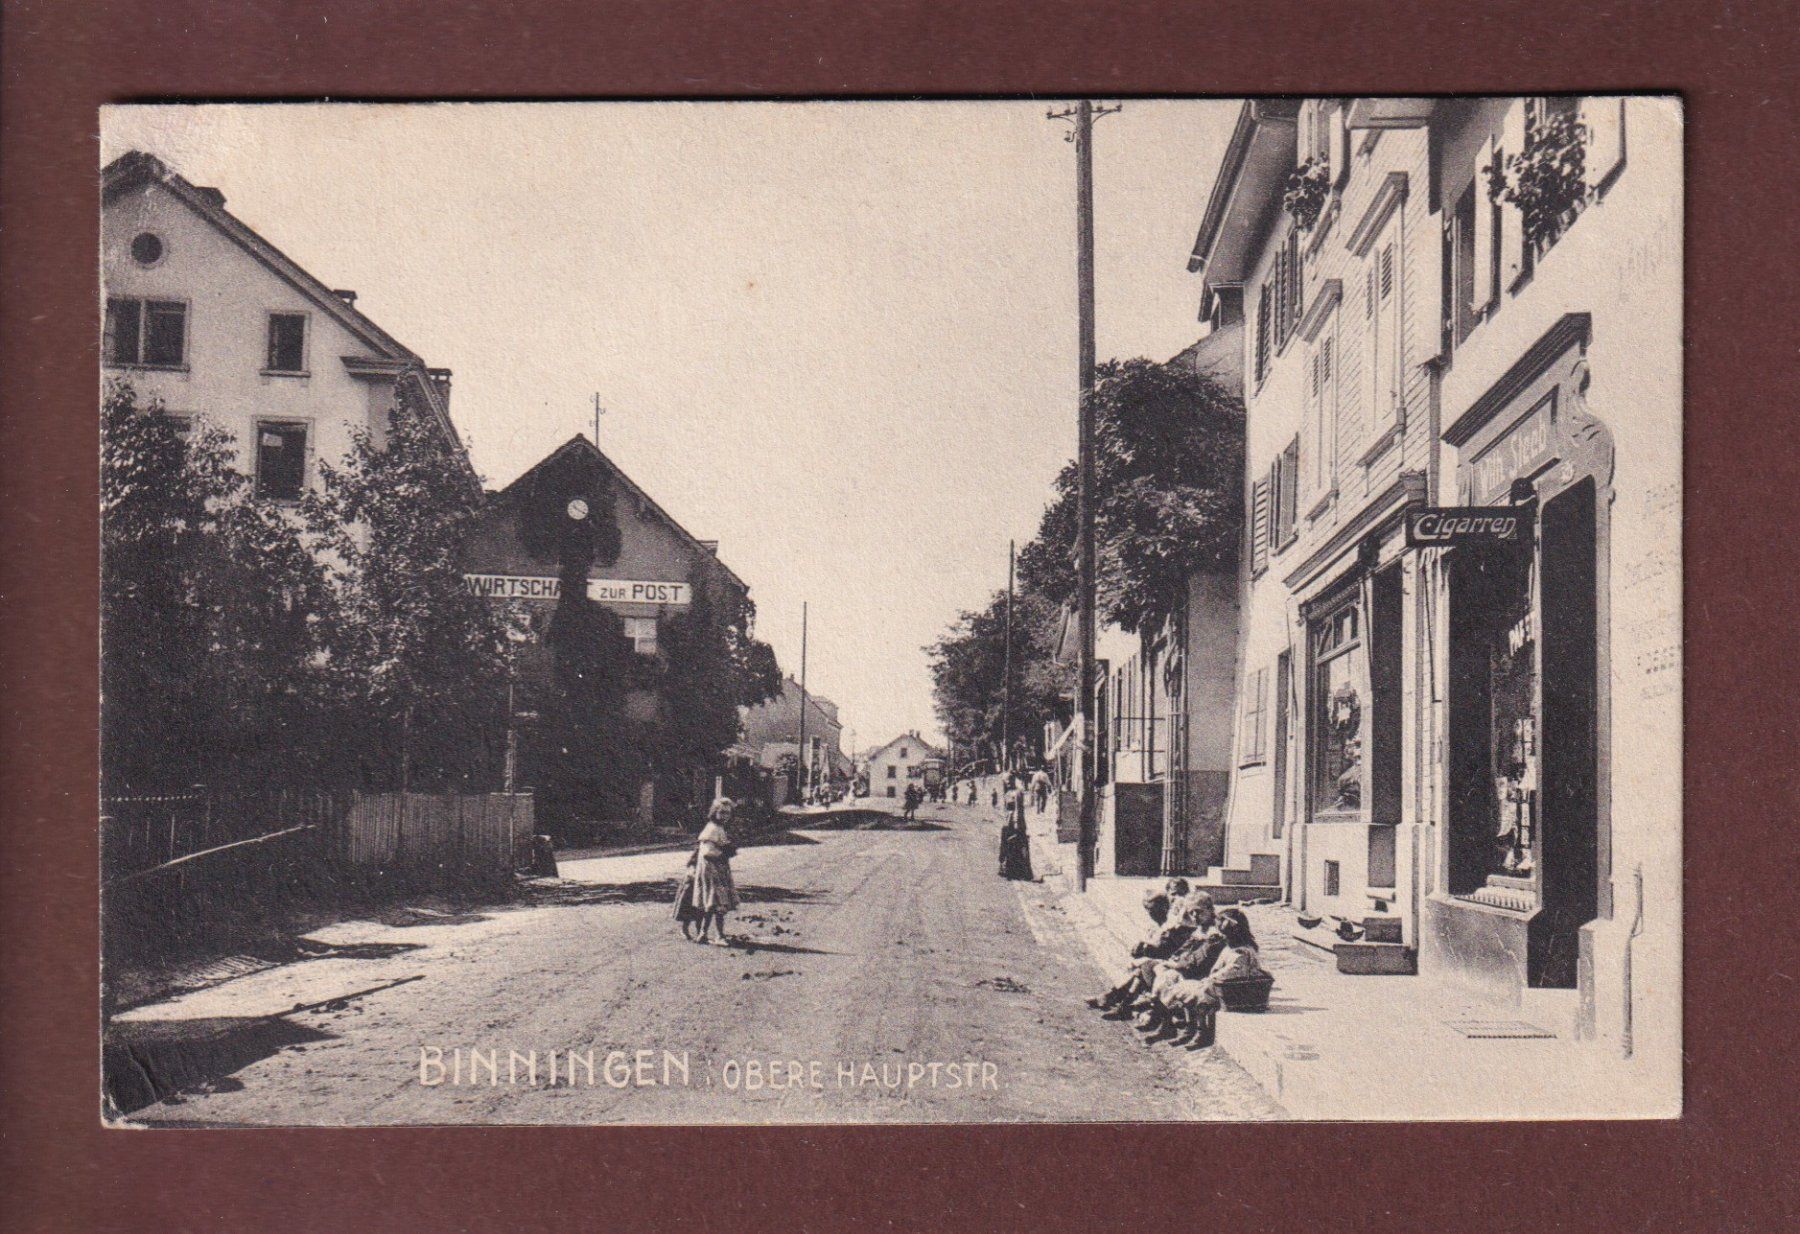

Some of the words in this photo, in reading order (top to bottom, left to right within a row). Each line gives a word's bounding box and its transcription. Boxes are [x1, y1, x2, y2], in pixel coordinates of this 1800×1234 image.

[1413, 512, 1517, 540] Cigarren
[600, 587, 627, 599] ZUR
[632, 583, 684, 600] POST
